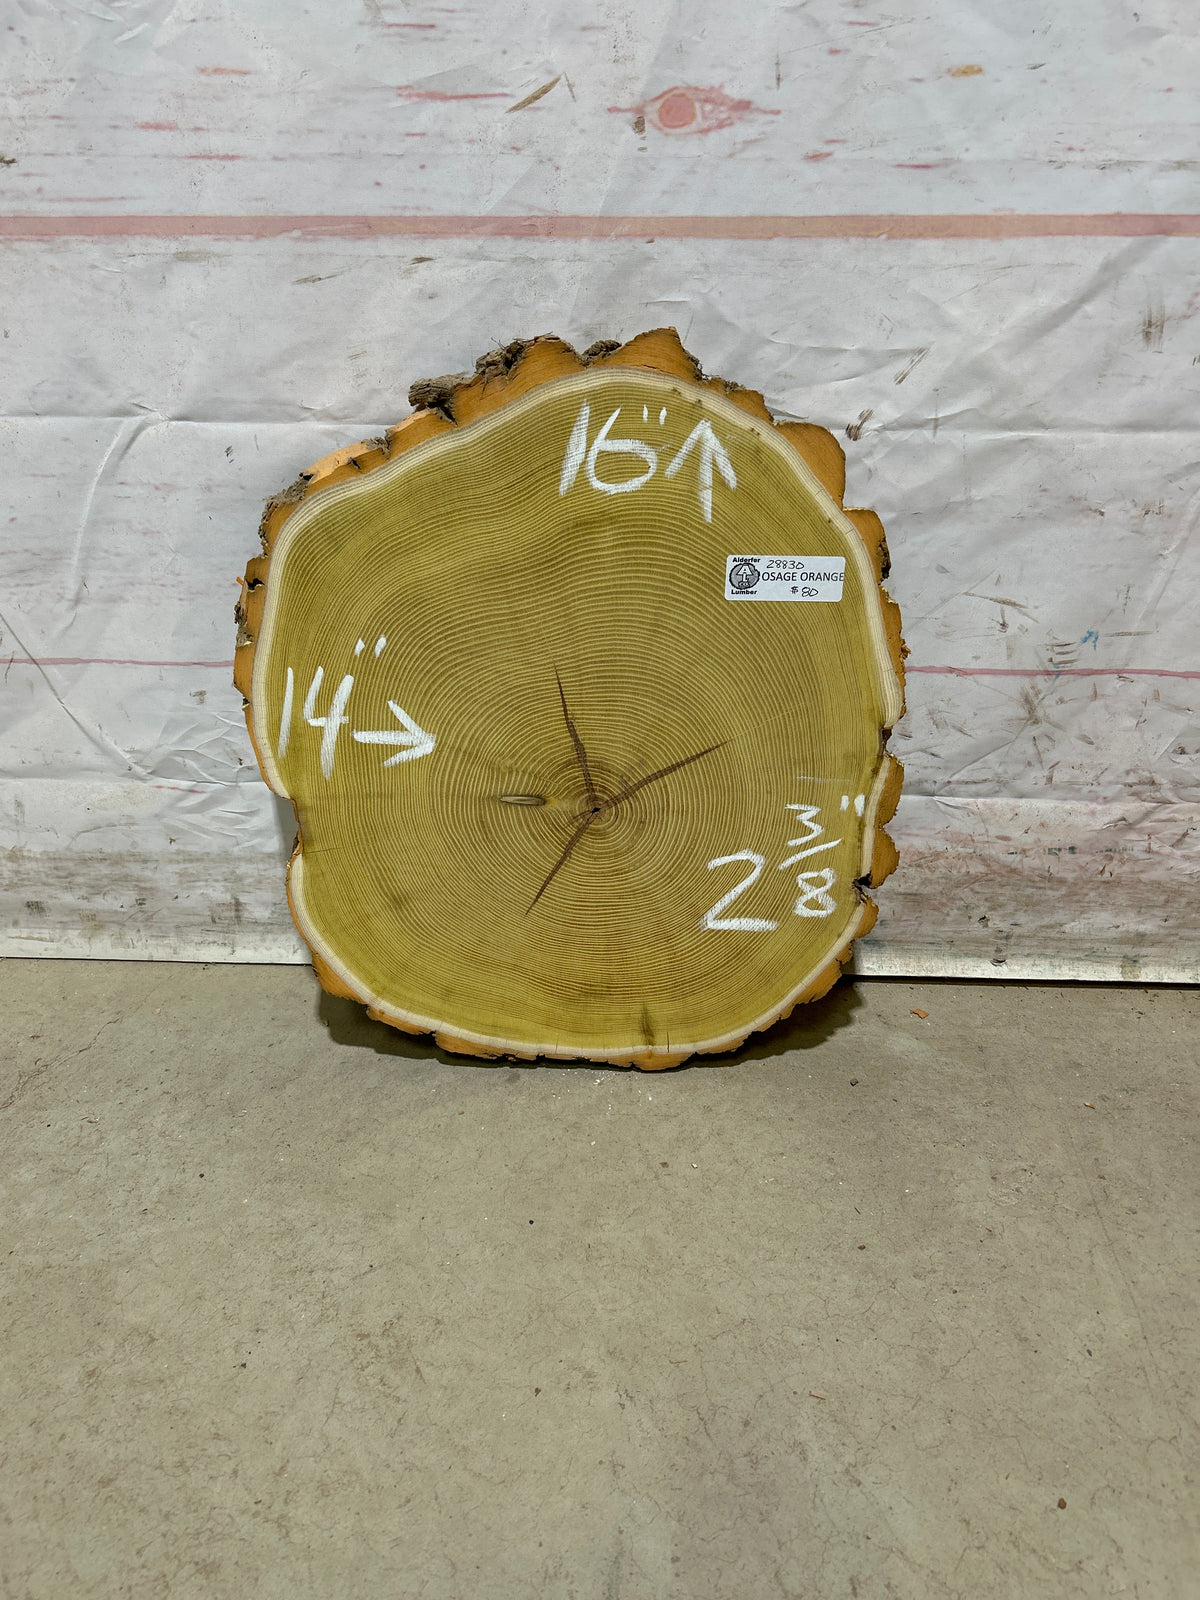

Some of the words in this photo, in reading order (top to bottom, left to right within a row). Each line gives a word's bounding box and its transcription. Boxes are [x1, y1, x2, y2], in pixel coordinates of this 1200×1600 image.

[766, 559, 805, 570] 28830
[761, 571, 798, 582] OSAGE
[800, 571, 844, 582] ORANGE
